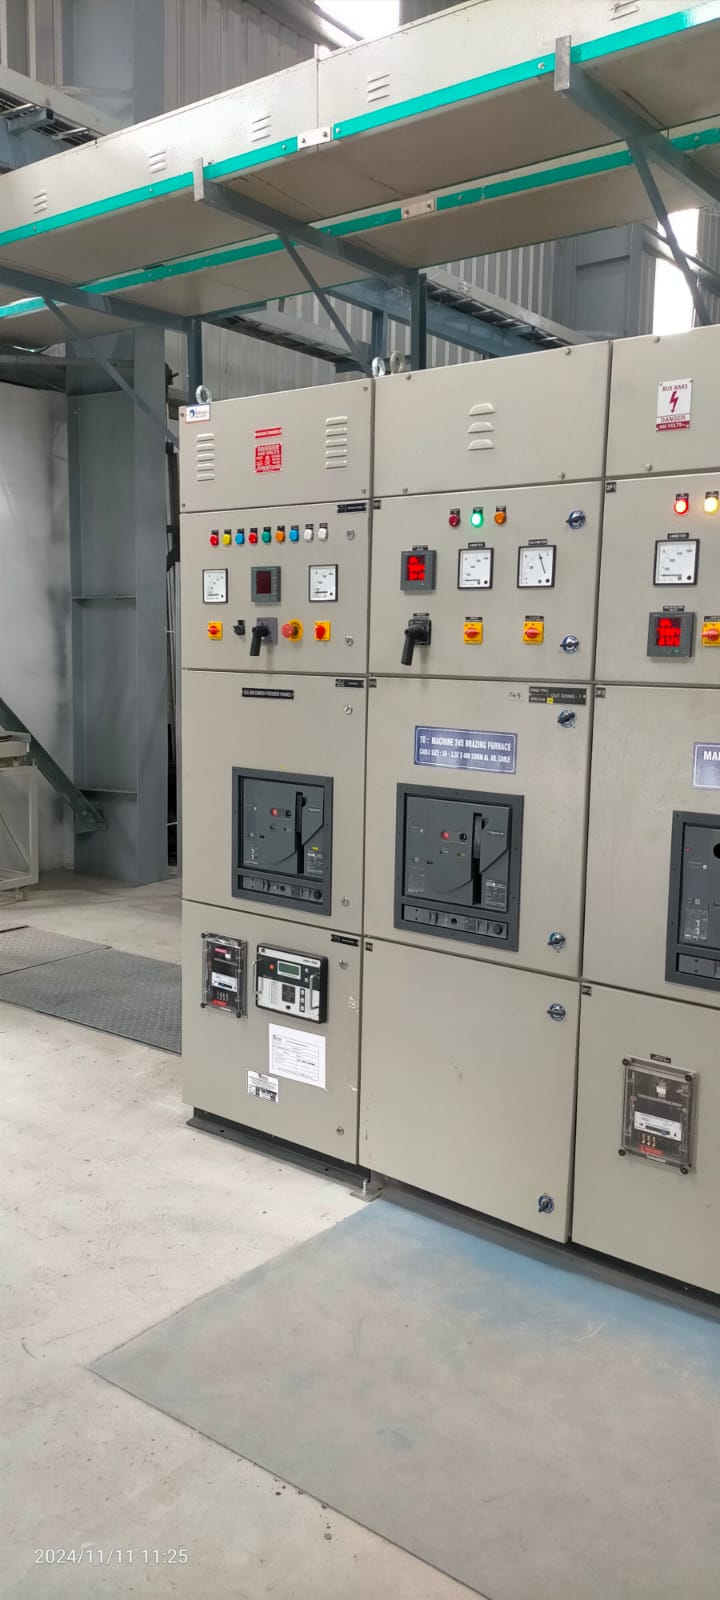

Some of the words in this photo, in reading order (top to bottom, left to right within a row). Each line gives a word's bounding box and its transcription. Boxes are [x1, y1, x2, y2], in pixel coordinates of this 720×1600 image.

[432, 737, 454, 746] MACHINE
[465, 739, 487, 749] BRAZING
[488, 741, 511, 751] FURNACE
